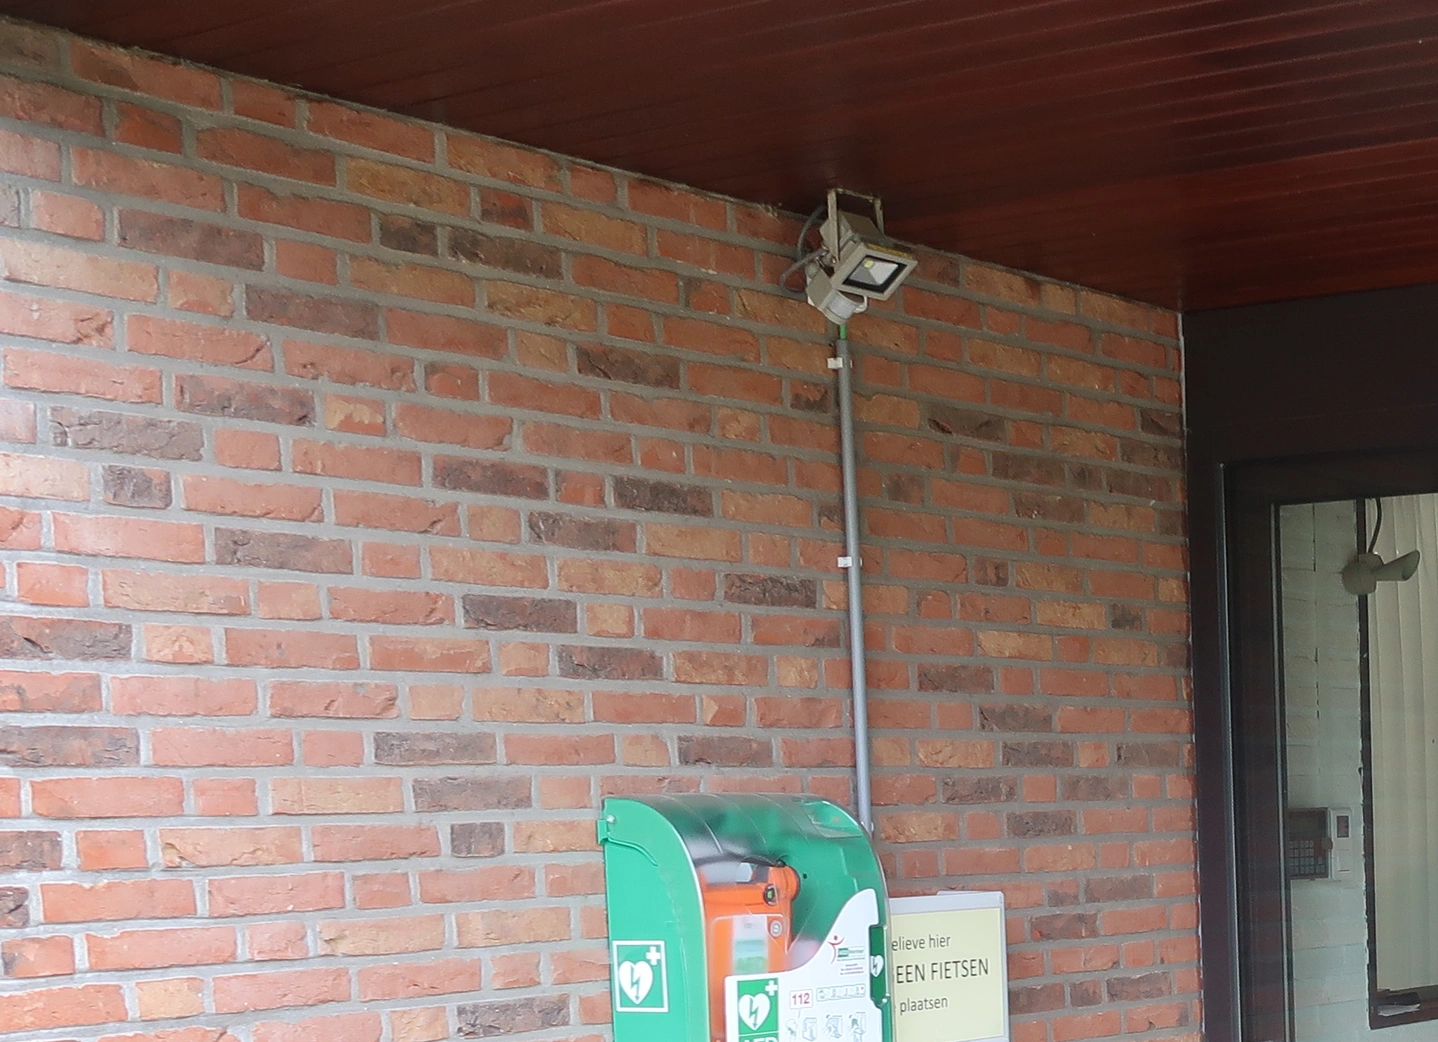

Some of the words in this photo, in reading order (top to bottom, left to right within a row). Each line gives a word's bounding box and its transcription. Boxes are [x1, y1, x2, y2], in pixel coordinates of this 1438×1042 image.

[891, 936, 926, 951] elieve
[929, 934, 951, 948] hier
[896, 963, 925, 984] EEN
[931, 958, 988, 980] FIETSEN
[792, 992, 810, 1006] 112
[900, 997, 948, 1016] plaatsen
